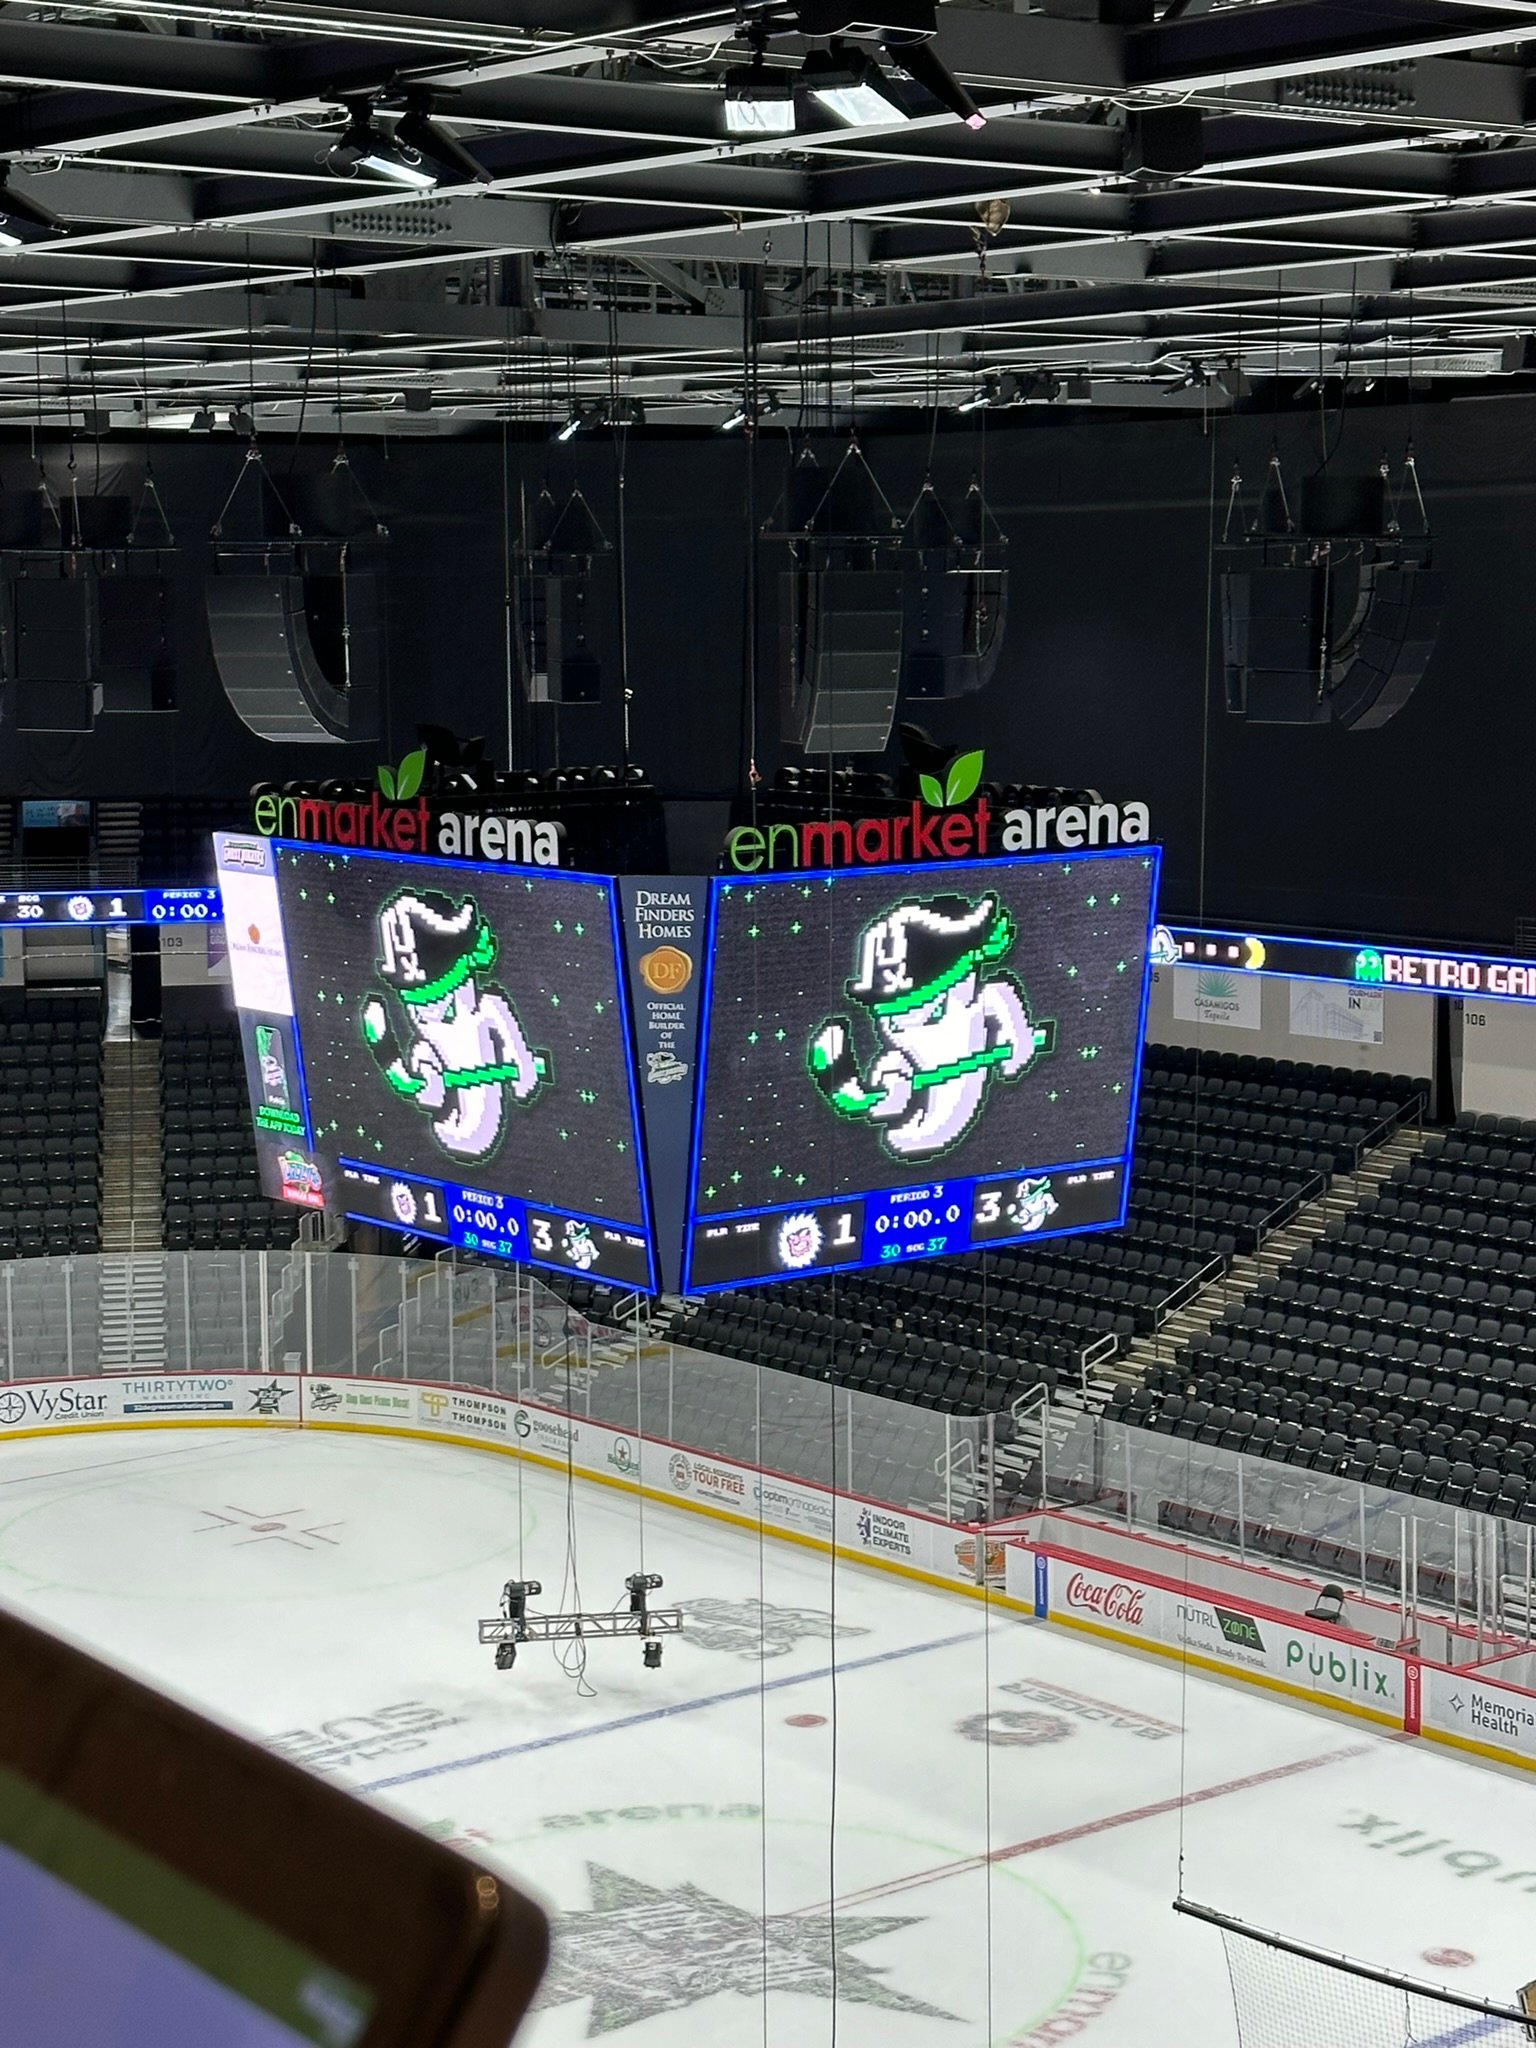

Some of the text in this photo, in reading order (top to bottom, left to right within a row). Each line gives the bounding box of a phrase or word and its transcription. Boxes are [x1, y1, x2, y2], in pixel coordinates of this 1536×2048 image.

[254, 790, 560, 866] enmarket arena
[729, 798, 1150, 872] enmarket arena
[207, 891, 216, 899] 3
[636, 891, 691, 906] DREAM
[16, 904, 44, 919] 30
[109, 898, 127, 917] 1
[634, 907, 695, 923] FINDERS
[638, 923, 692, 939] HOMES
[1383, 954, 1480, 990] RETRO
[1465, 1013, 1486, 1026] 106
[462, 1190, 504, 1209] PERIOD 3
[890, 1185, 944, 1204] PERIOD 3
[424, 1191, 442, 1223] 1
[975, 1191, 1002, 1223] 3
[453, 1204, 520, 1237] 0:00.0
[833, 1213, 856, 1245] 1
[875, 1204, 960, 1234] 0:00.0
[463, 1231, 479, 1246] 30
[498, 1240, 513, 1254] 37
[532, 1218, 553, 1252] 3
[881, 1244, 901, 1259] 30
[927, 1236, 947, 1251] 37
[26, 1387, 108, 1420] VyStar
[452, 1397, 507, 1415] THOMPSON
[452, 1412, 507, 1431] THOMPSON
[692, 1470, 719, 1488] TOUR
[720, 1478, 746, 1496] FREE
[872, 1513, 906, 1531] INDOOR
[872, 1526, 909, 1544] CLIMATE
[872, 1536, 912, 1555] EXPERTS
[1472, 1693, 1536, 1727] Memoria
[1472, 1711, 1519, 1737] Health
